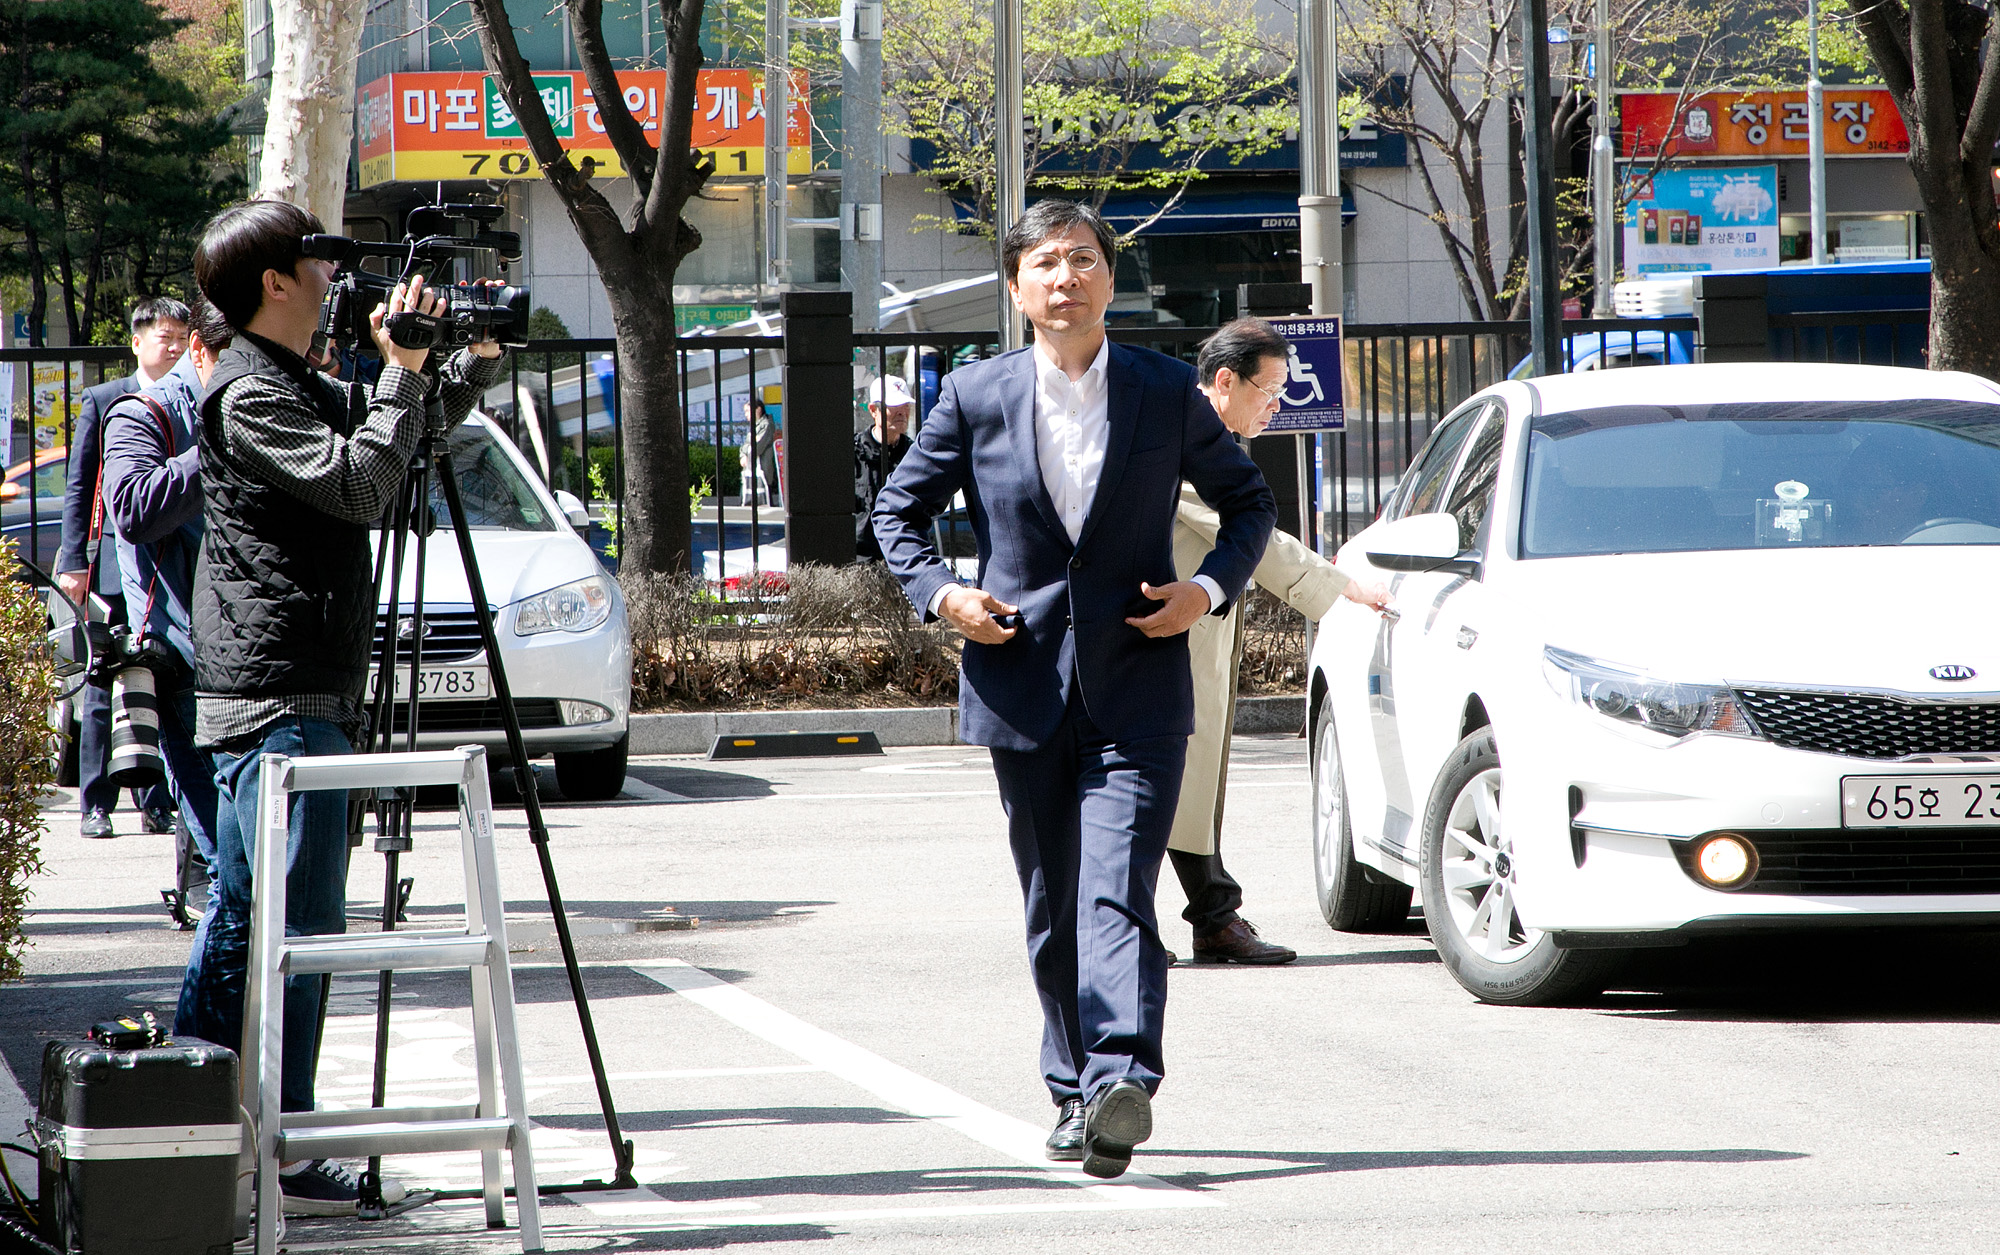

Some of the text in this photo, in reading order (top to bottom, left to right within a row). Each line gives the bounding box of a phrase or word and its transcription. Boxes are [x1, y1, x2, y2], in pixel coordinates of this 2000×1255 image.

[403, 89, 480, 133] 마포
[1729, 101, 1875, 146] 정관장
[1261, 217, 1298, 228] EDIYA
[415, 316, 436, 327] Canon
[418, 671, 476, 694] 3783
[1932, 665, 1974, 679] KIA
[1866, 784, 1942, 820] 65호
[1422, 801, 1437, 879] KUMHO
